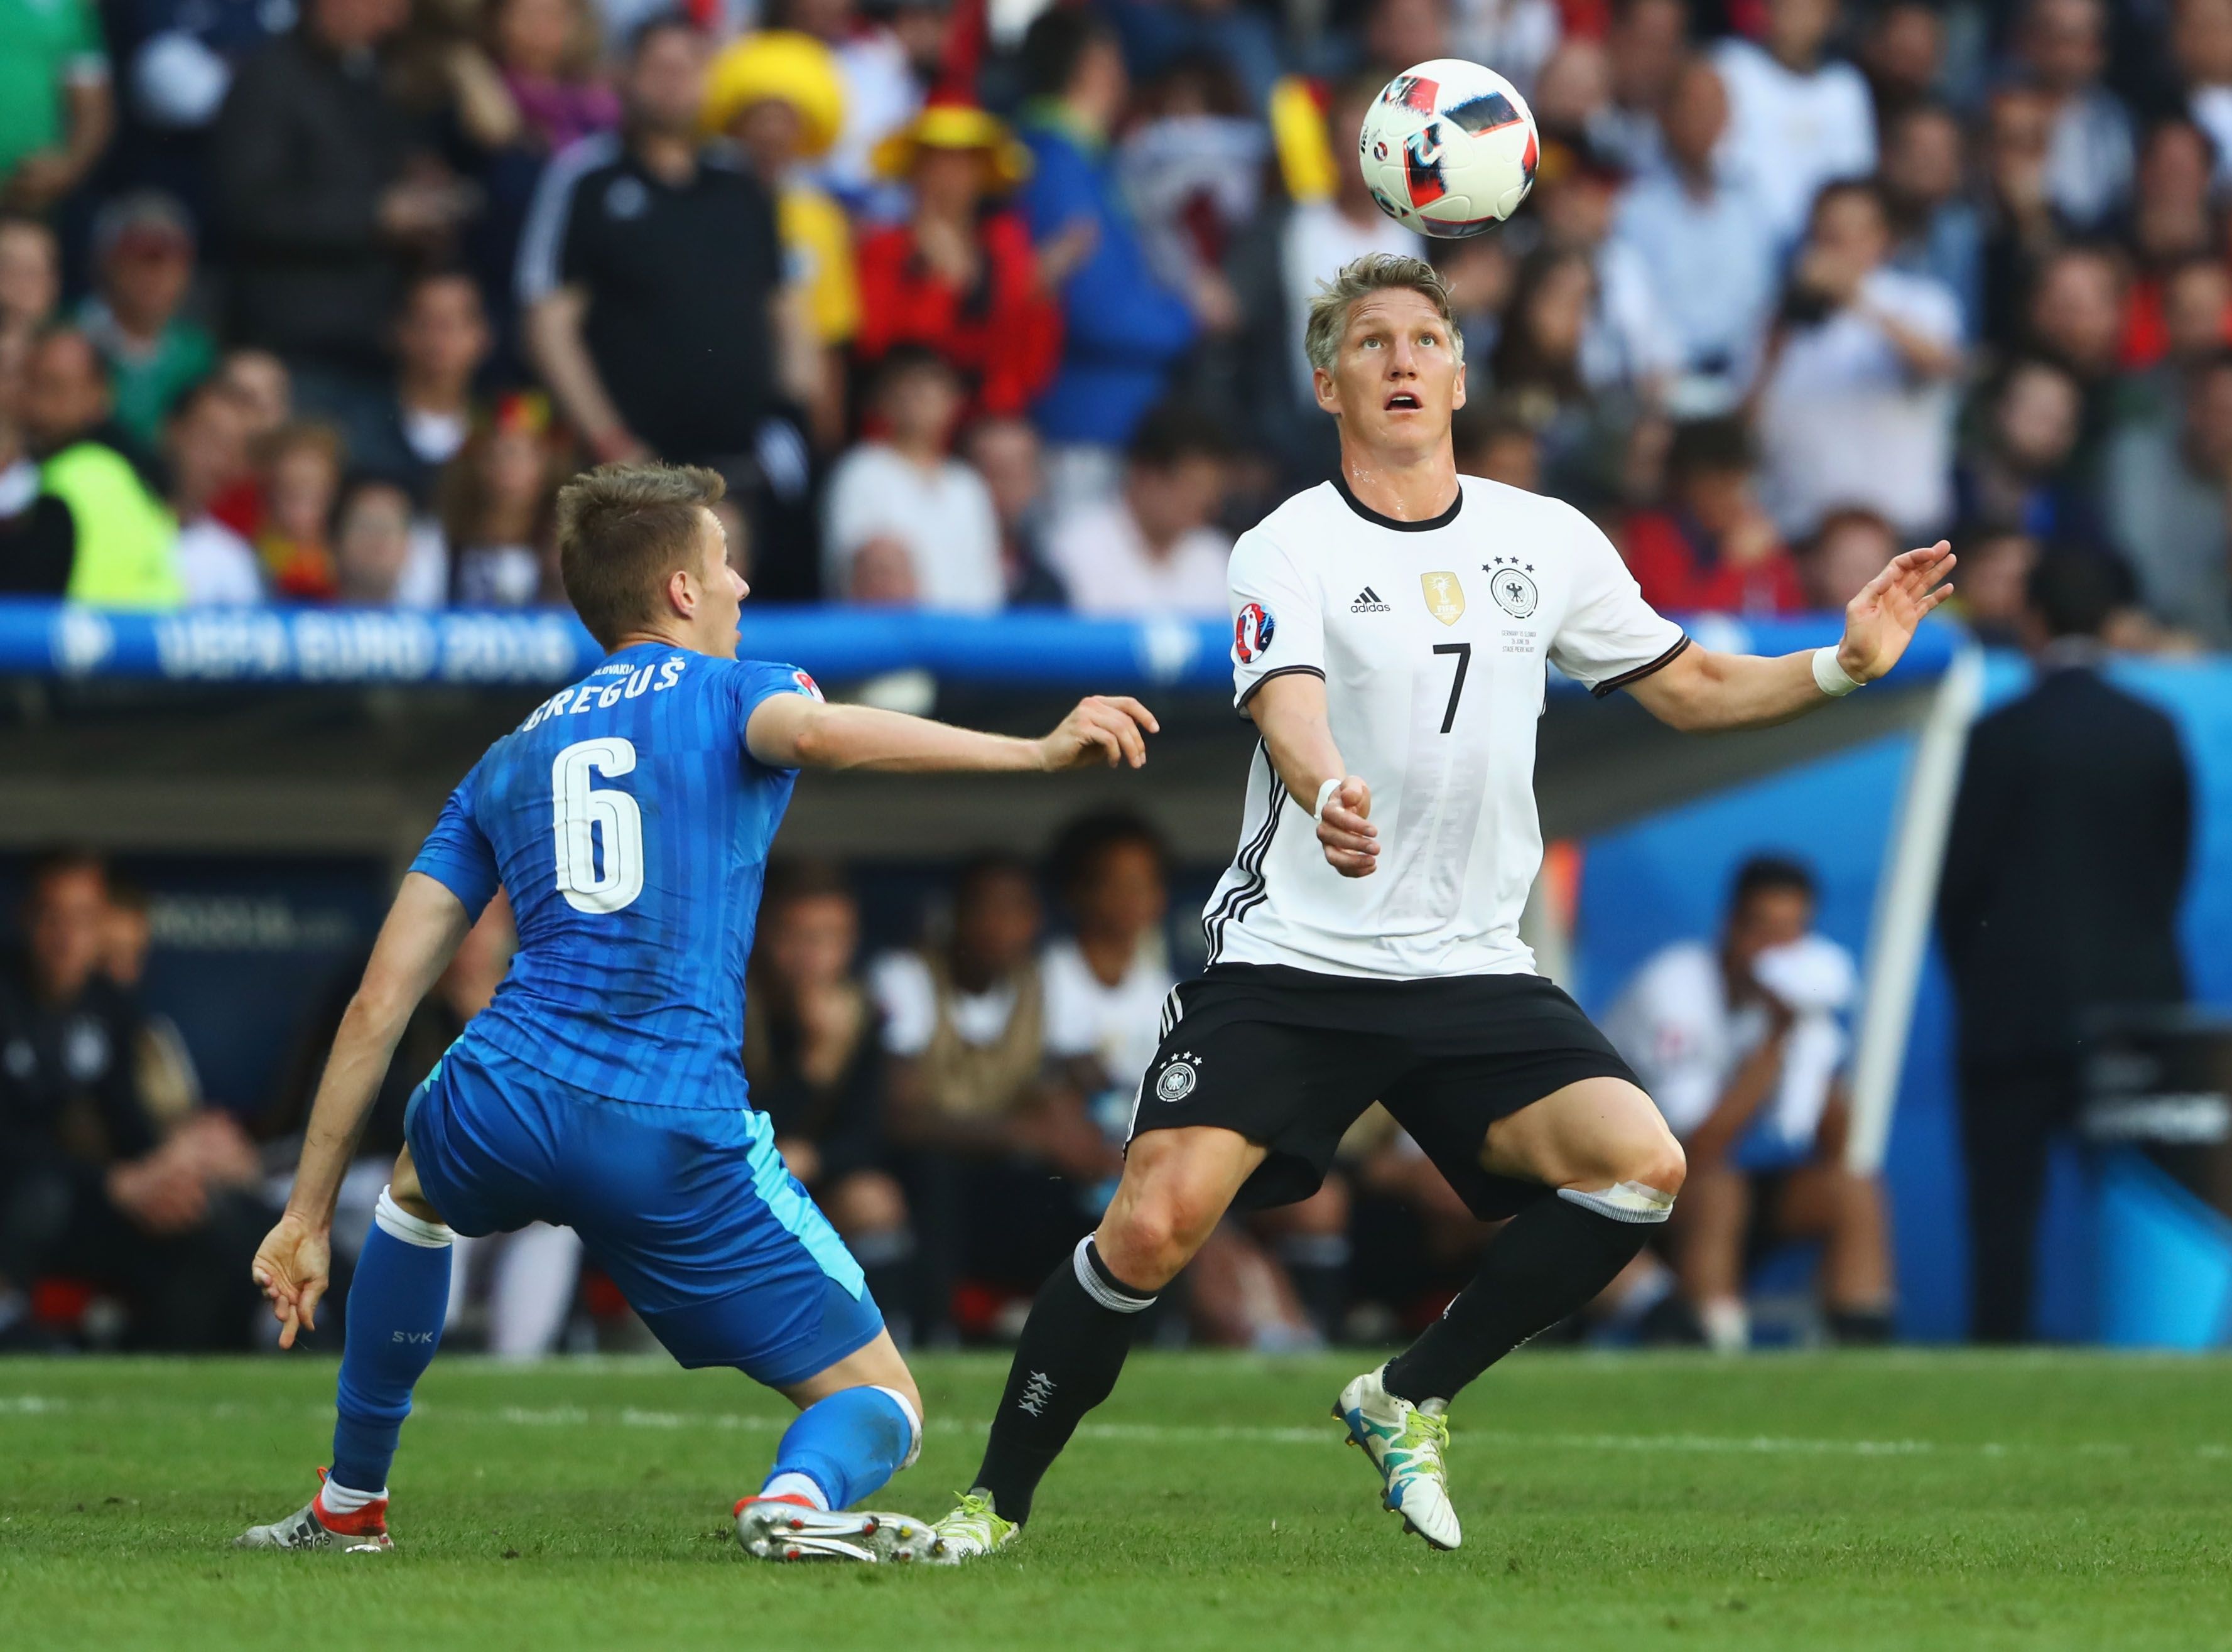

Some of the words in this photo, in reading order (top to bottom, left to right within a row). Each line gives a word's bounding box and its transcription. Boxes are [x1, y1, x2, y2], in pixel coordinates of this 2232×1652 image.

[1351, 601, 1390, 613] adidas
[1436, 604, 1456, 613] FIFA
[522, 657, 686, 732] GREGUŠ
[1433, 642, 1471, 733] 7
[551, 737, 644, 914] 6
[392, 1331, 433, 1344] SVK
